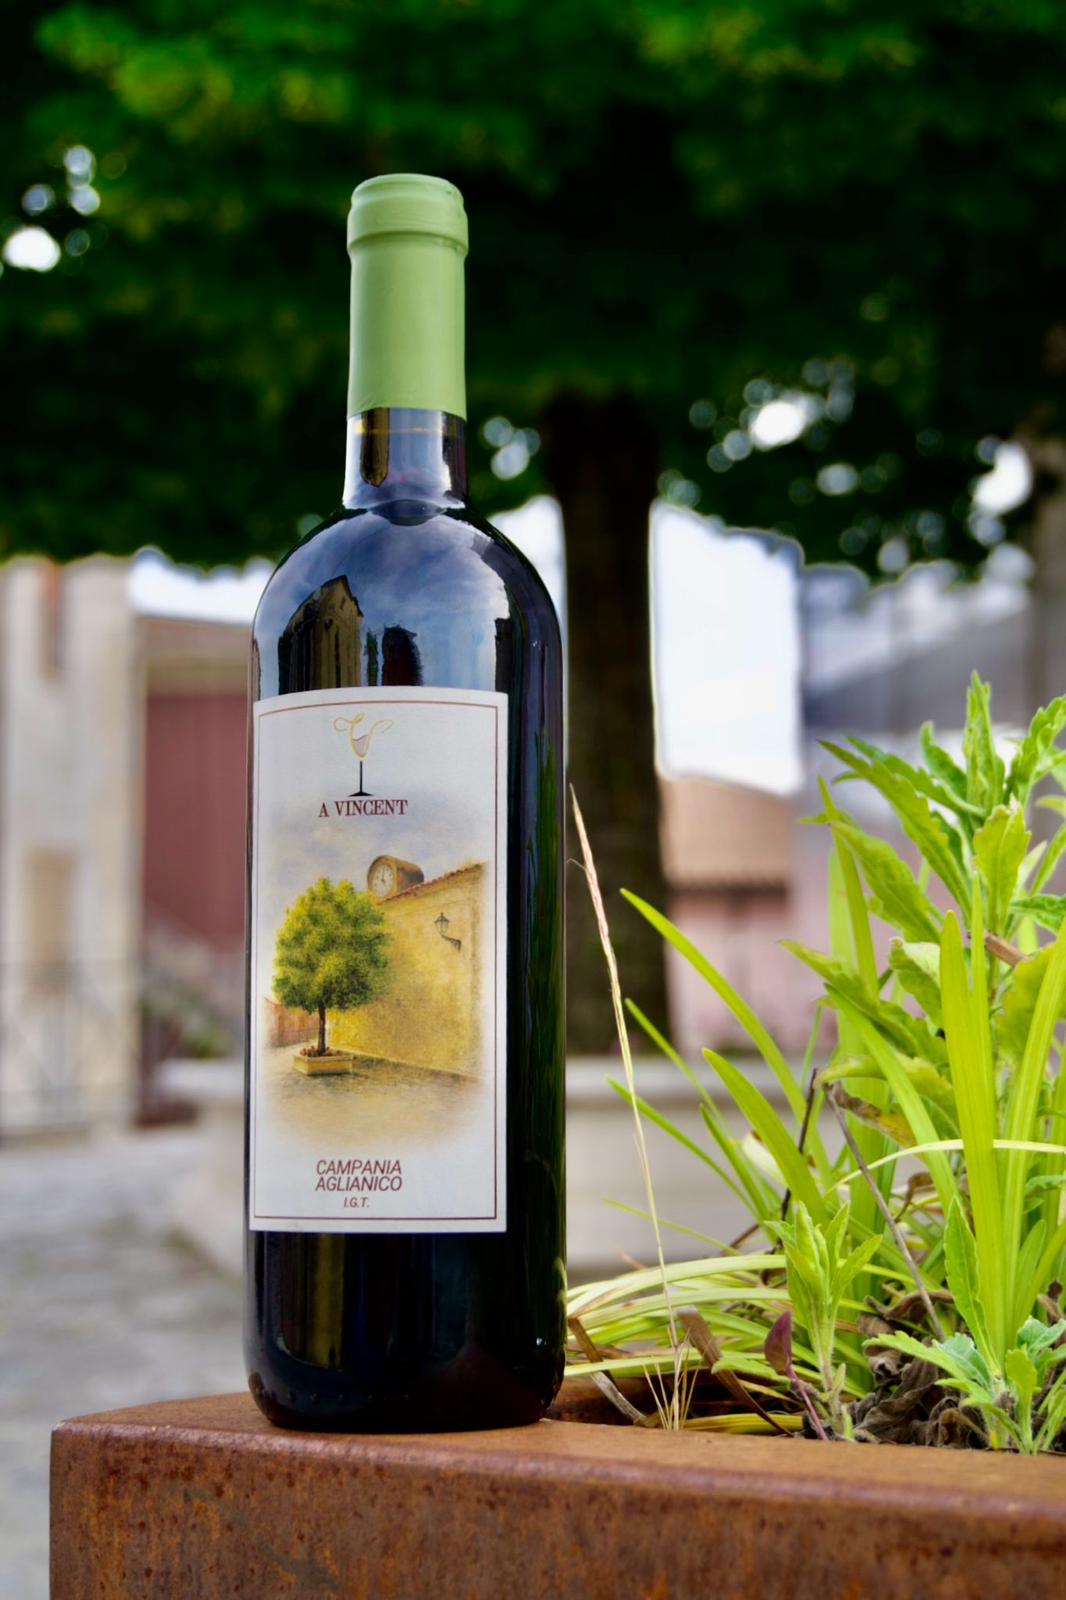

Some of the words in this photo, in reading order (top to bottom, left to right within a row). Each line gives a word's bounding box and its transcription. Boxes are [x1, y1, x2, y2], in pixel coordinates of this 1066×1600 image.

[318, 802, 328, 818] A
[334, 799, 408, 816] VINCENT
[316, 1159, 402, 1175] CAMPANIA
[315, 1175, 403, 1192] AGLIANICO
[343, 1197, 370, 1208] I.G.T.
